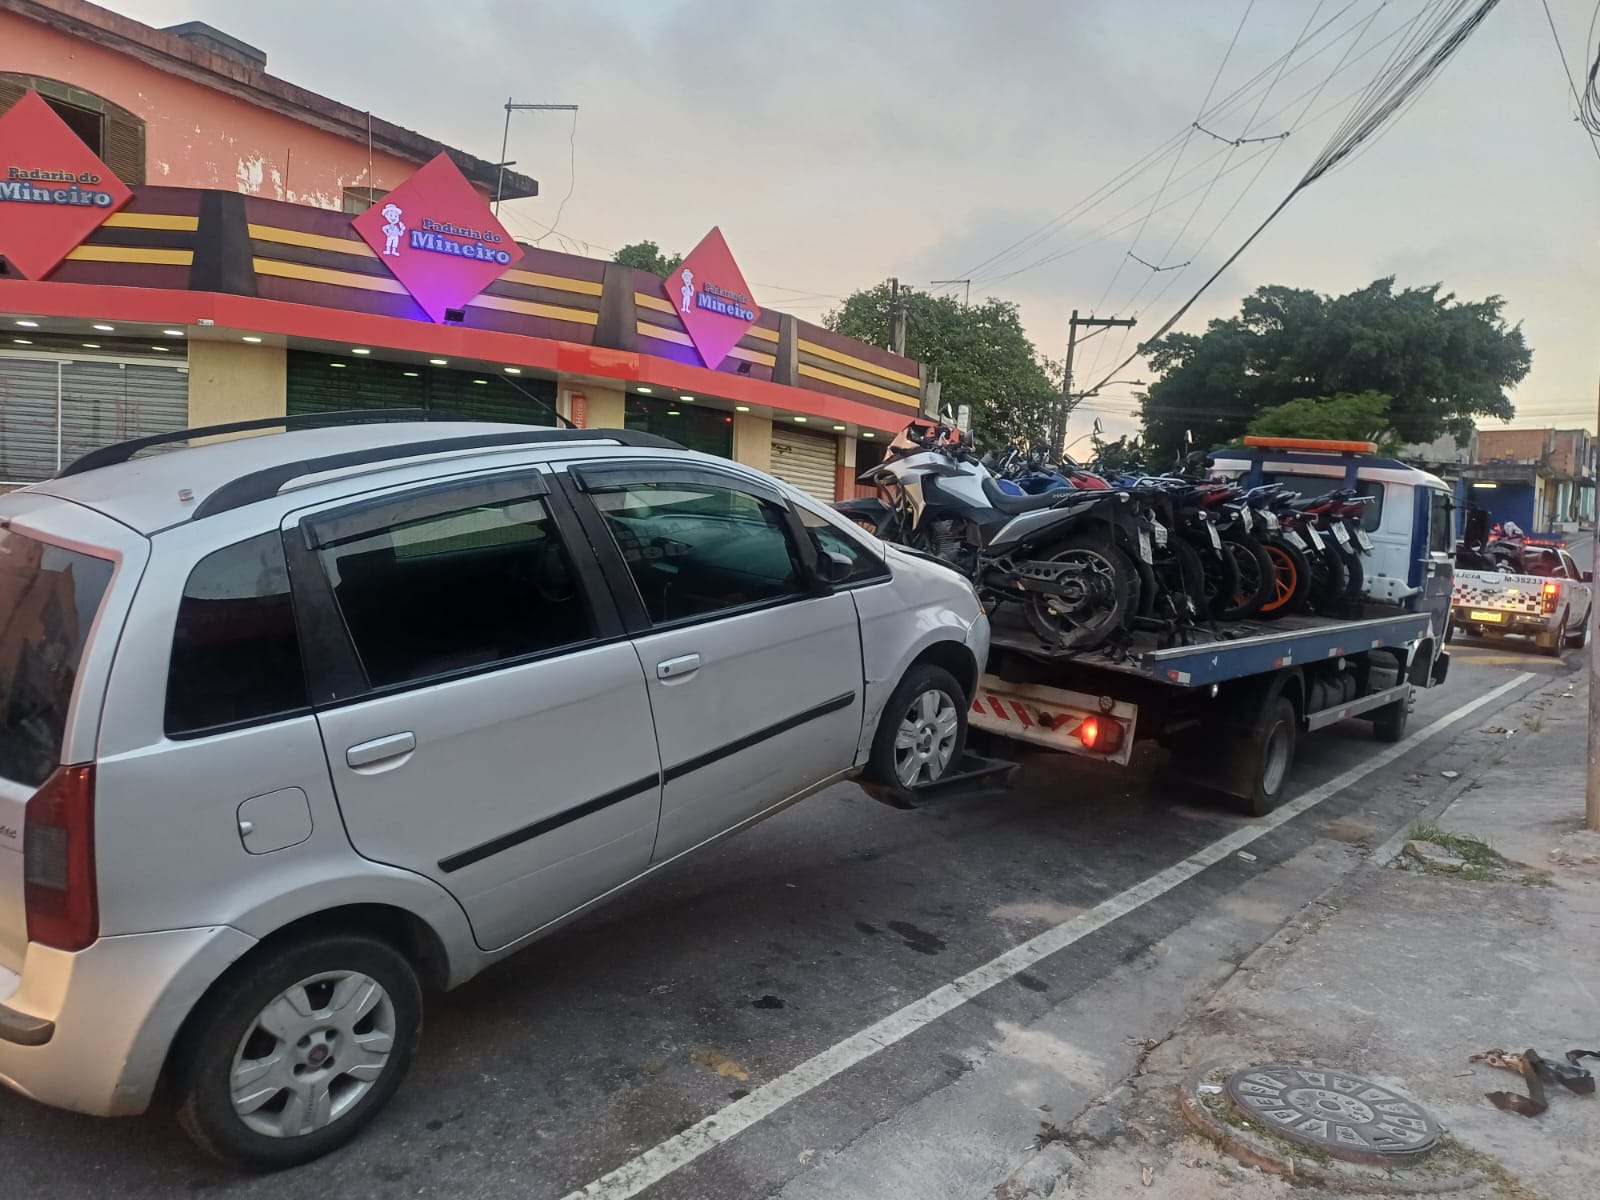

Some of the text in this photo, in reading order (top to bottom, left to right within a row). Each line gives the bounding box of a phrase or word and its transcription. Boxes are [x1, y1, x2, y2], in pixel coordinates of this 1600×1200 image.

[8, 166, 101, 184] Padaria do
[0, 181, 113, 208] Mineiro
[422, 218, 502, 243] Padaria do
[409, 229, 512, 265] Mineiro
[696, 292, 755, 322] Mineiro
